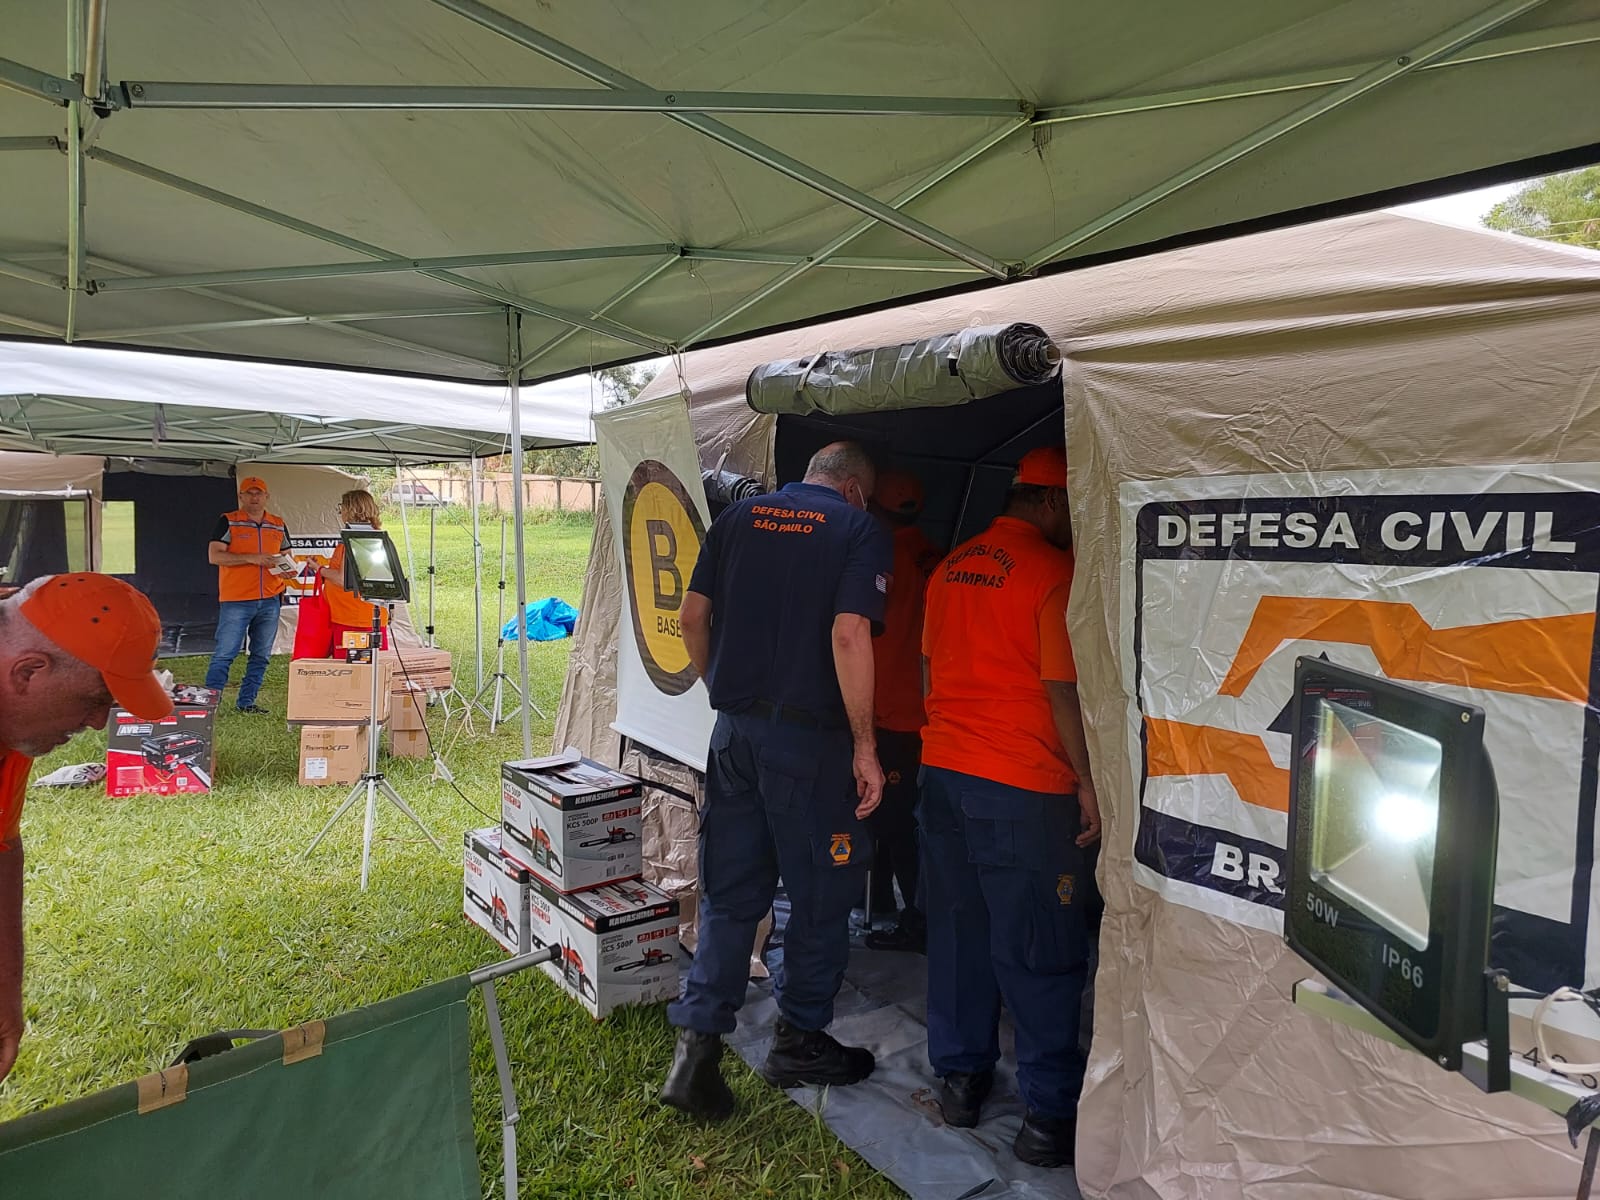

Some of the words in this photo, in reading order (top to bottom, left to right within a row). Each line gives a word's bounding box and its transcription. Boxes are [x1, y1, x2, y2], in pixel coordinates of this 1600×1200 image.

[751, 505, 795, 519] DEFESA
[797, 510, 827, 523] CIVIL
[753, 519, 778, 531] SÃO
[778, 523, 814, 534] PAULO
[1157, 510, 1360, 549] DEFESA
[1379, 510, 1577, 554] CIVIL
[291, 539, 313, 547] ESA
[315, 539, 339, 547] CIVI
[646, 519, 683, 611] B
[657, 615, 683, 638] BASE
[120, 725, 140, 734] AVR
[566, 821, 581, 830] KCS
[1210, 841, 1286, 895] BR
[1305, 891, 1340, 929] 50W
[616, 939, 634, 950] 500P
[1382, 943, 1424, 989] IP66
